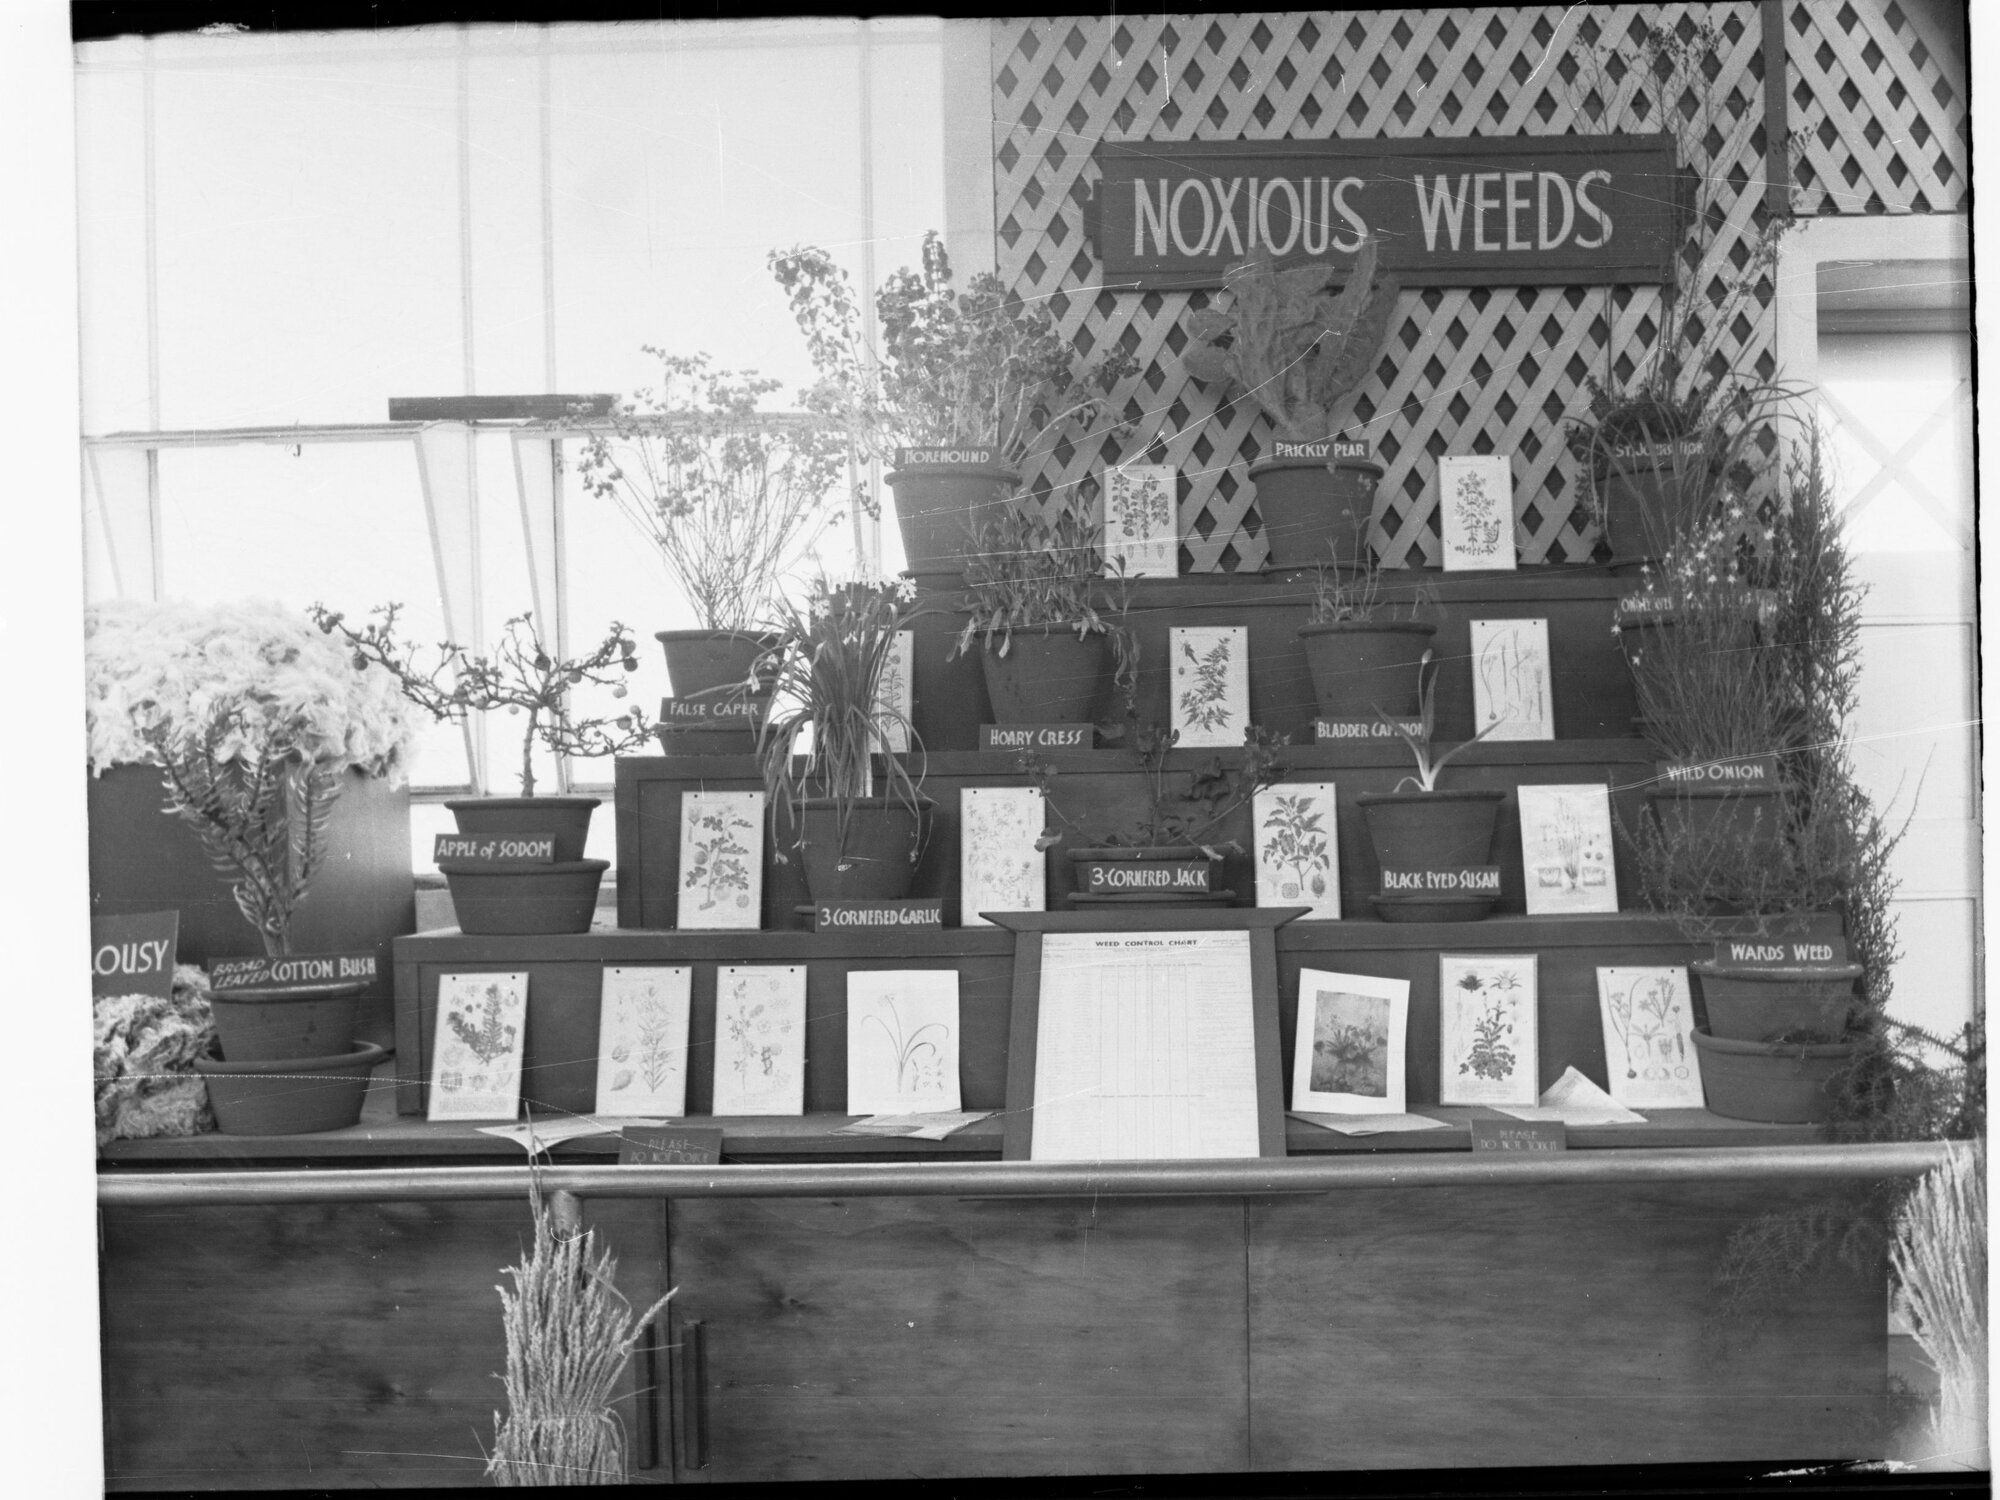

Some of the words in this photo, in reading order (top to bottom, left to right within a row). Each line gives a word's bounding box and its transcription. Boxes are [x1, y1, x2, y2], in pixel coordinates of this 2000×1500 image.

[1134, 176, 1368, 257] NOXIOUS
[1413, 169, 1614, 252] WEEDS
[904, 449, 990, 465] HOREHOUND
[1275, 442, 1330, 457] PRICKLY
[1333, 443, 1365, 458] PEAR
[670, 701, 706, 716] FALSE
[713, 702, 759, 716] CAPER
[990, 729, 1034, 745] HOARY
[1038, 728, 1084, 745] CRESS
[1318, 721, 1369, 738] BLADDER
[1666, 765, 1705, 781] WILD
[1708, 764, 1764, 780] ONION
[437, 839, 477, 857] APPLE
[480, 841, 496, 860] of
[499, 840, 552, 857] SODOM
[1172, 867, 1206, 887] JACK
[1459, 869, 1499, 889] SUSAN
[820, 907, 831, 926] 3
[833, 908, 898, 926] CORNERED
[899, 907, 941, 925] GARLIC
[1124, 939, 1164, 947] CONTROL
[1731, 943, 1784, 960] WARDS
[1793, 943, 1833, 960] WEED
[92, 940, 169, 976] OUSY
[213, 959, 266, 977] BROAD
[271, 960, 334, 981] COTTON
[340, 957, 377, 978] BUSH
[1499, 1129, 1538, 1140] PLEASE
[1480, 1139, 1497, 1150] DO
